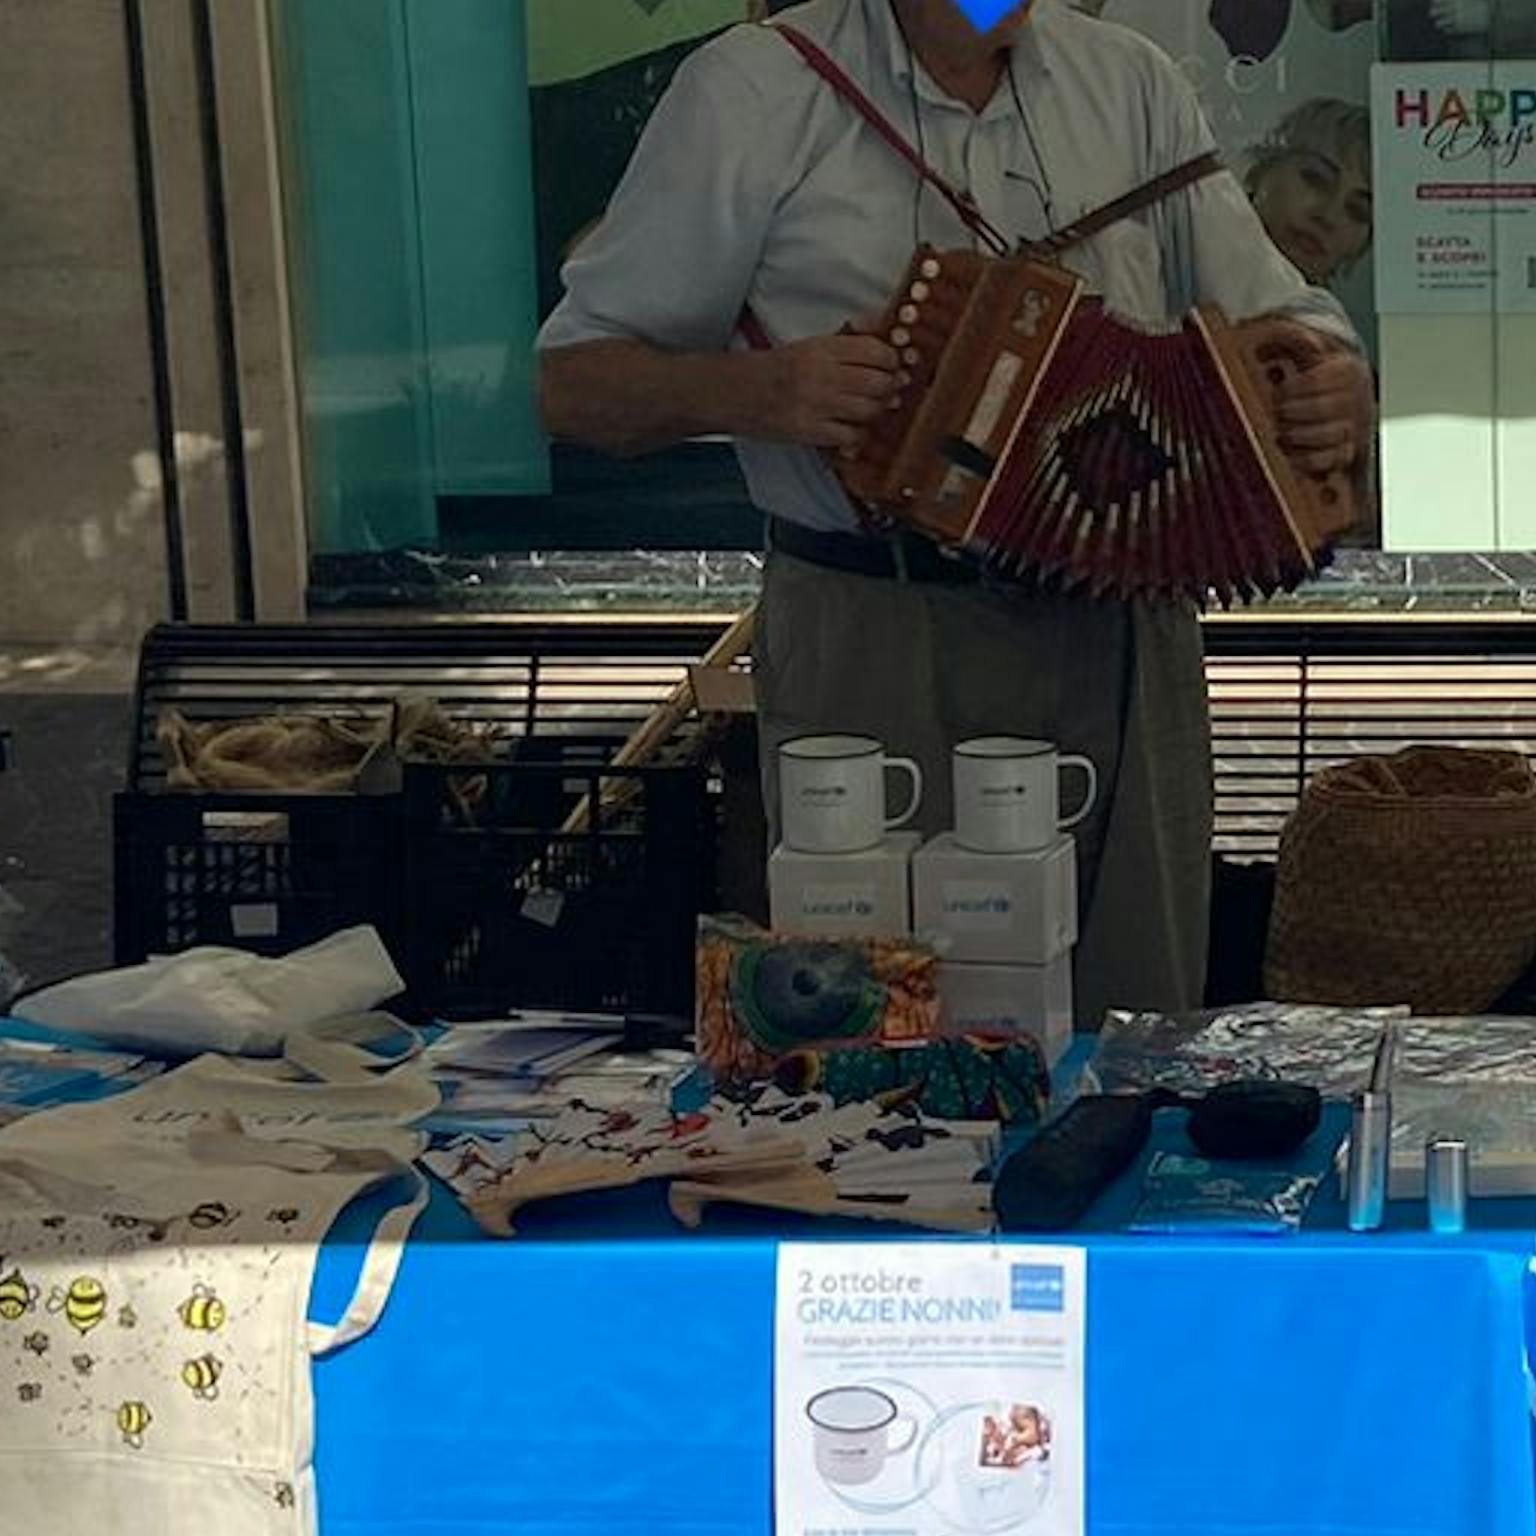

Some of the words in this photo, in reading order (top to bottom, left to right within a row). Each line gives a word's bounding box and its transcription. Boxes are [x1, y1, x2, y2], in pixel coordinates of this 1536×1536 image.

[798, 1271, 814, 1294] 2
[821, 1270, 923, 1294] ottobre
[798, 1299, 895, 1324] GRAZIE
